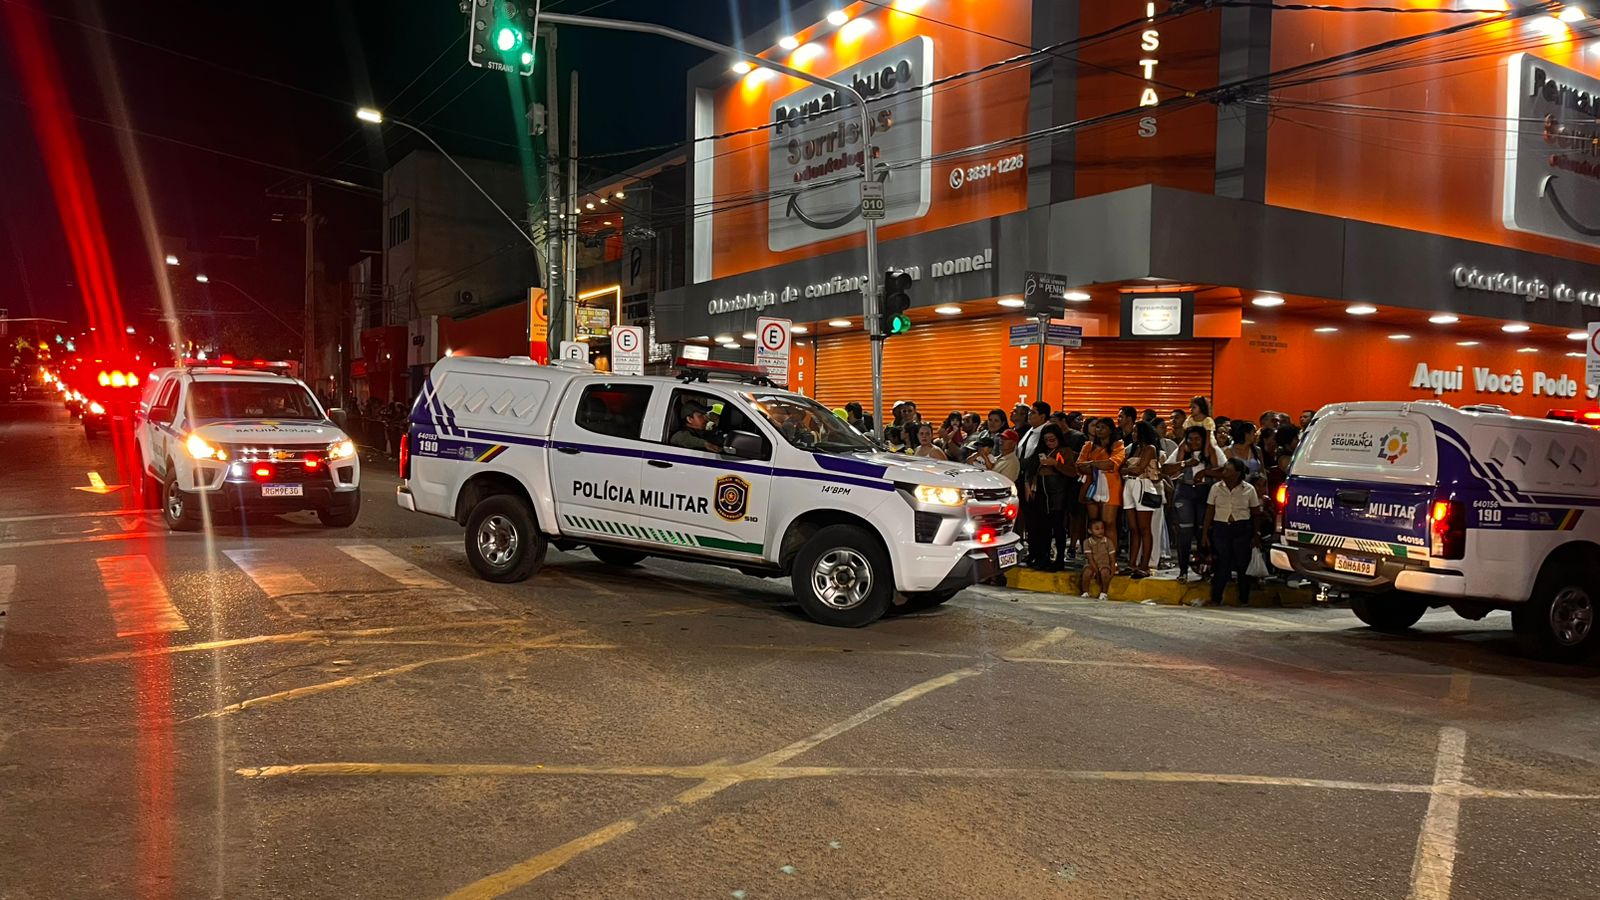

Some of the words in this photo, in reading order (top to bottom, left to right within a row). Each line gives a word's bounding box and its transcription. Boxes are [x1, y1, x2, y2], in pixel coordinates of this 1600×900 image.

[488, 61, 513, 72] STTRANS
[966, 154, 1024, 181] 3831-1228
[862, 199, 883, 209] 010
[708, 291, 776, 316] Odontologia
[781, 286, 800, 303] de
[805, 274, 869, 299] confianç
[931, 248, 993, 278] nome!
[1454, 266, 1550, 302] Odontologia
[1555, 283, 1576, 302] de
[624, 335, 631, 346] E
[770, 330, 778, 344] E
[1410, 362, 1464, 395] Aqui
[1473, 369, 1525, 394] Você
[1532, 371, 1578, 397] Pode
[419, 440, 439, 452] 190
[1331, 438, 1373, 448] SEGURANÇA
[573, 480, 636, 504] POLÍCIA
[639, 489, 709, 514] MILITAR
[1296, 493, 1333, 509] POLÍCIA
[1369, 502, 1416, 519] MILITAR
[1472, 500, 1499, 508] 640156
[1478, 508, 1502, 521] 190
